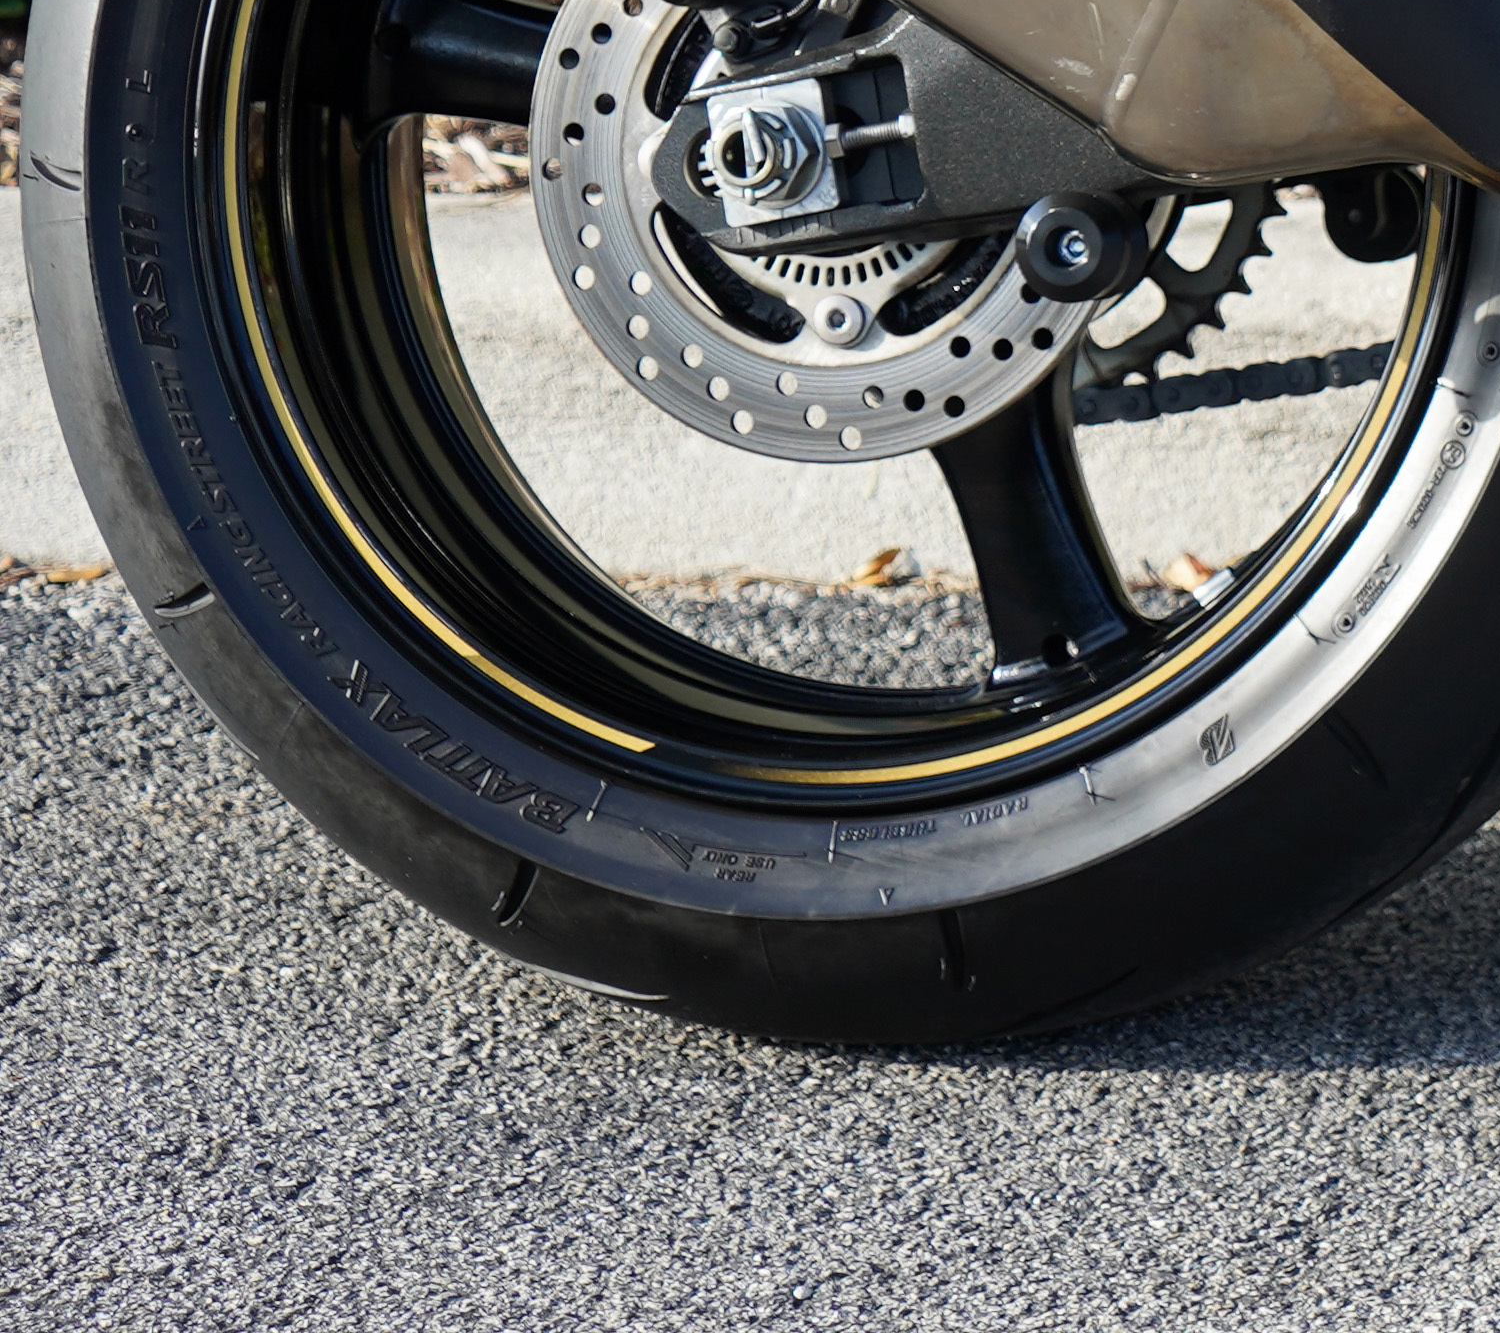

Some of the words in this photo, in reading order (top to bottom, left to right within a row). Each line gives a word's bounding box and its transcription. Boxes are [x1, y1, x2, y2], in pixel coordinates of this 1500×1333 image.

[121, 205, 174, 347] RS11
[152, 355, 238, 519] STREET
[224, 519, 335, 660] RACING
[324, 656, 582, 835] BATTLAX
[700, 849, 739, 866] ONLY
[713, 867, 755, 882] REAR
[743, 855, 776, 869] USE
